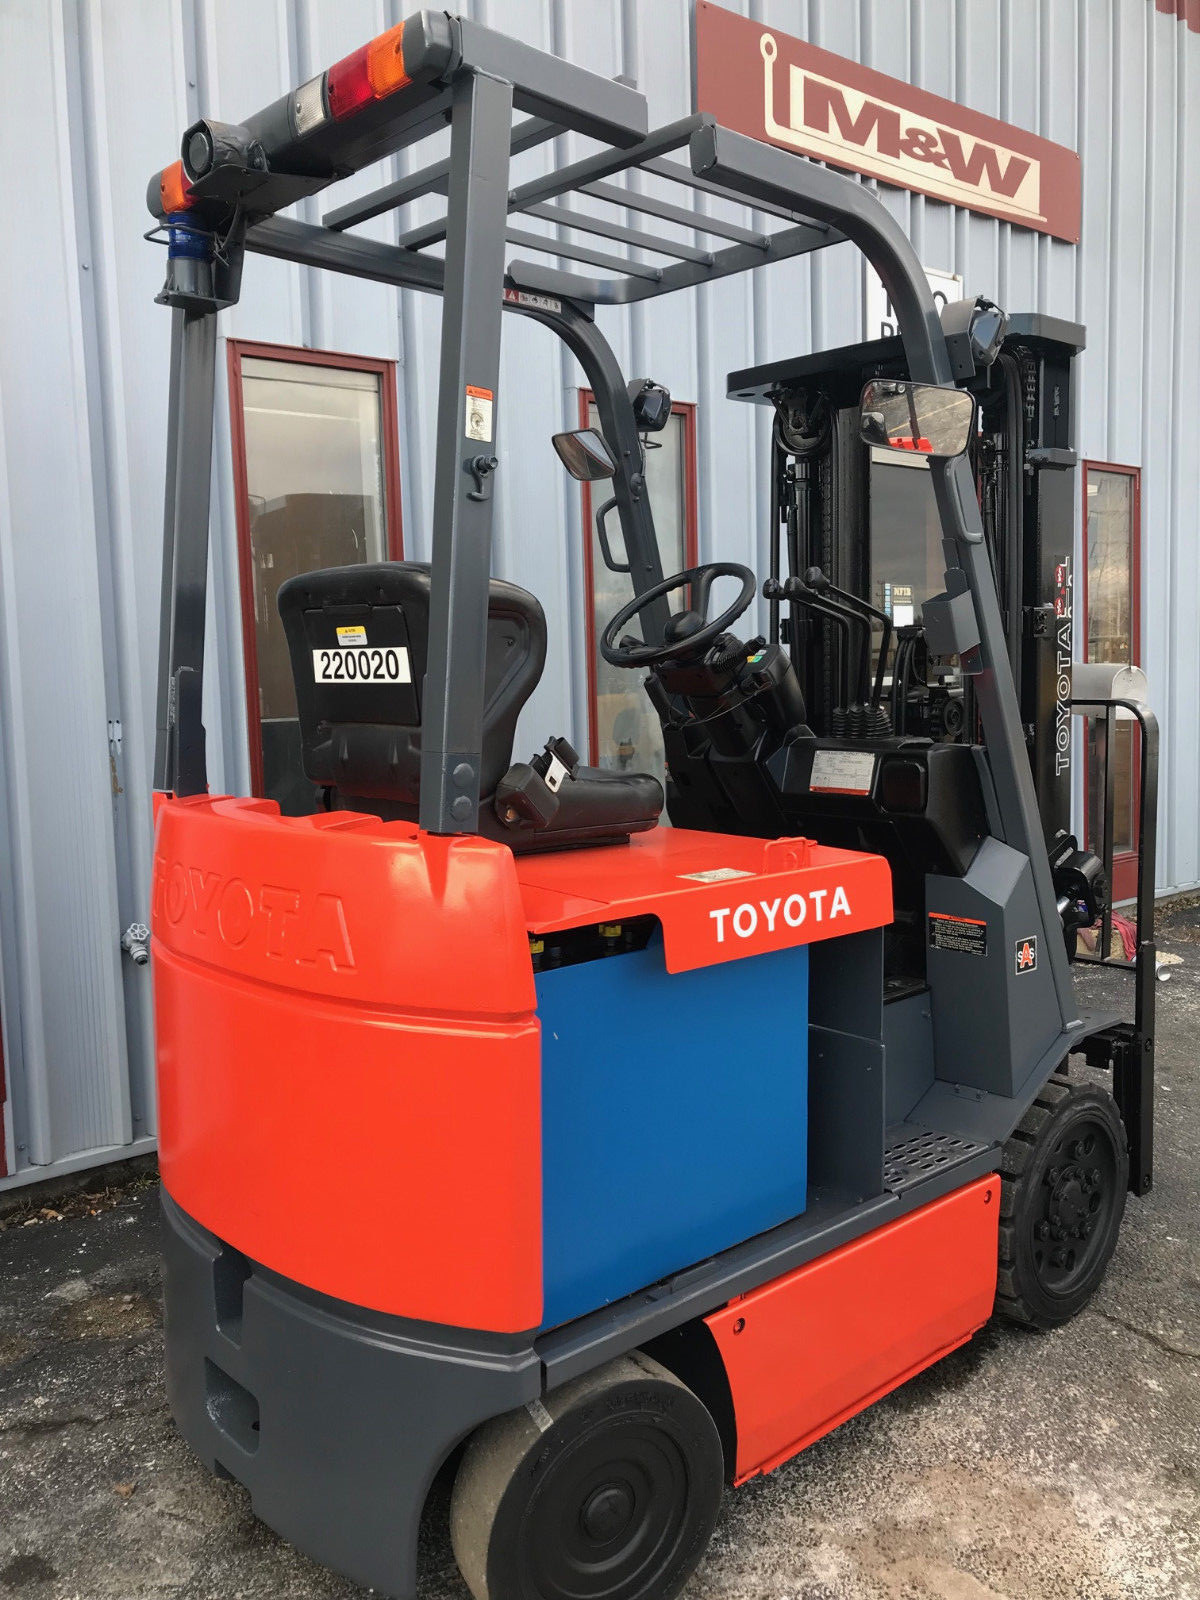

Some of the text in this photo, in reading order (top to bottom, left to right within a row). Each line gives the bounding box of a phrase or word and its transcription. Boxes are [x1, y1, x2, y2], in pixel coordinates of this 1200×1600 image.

[803, 75, 1031, 198] M&W
[320, 650, 399, 680] 220020
[1056, 623, 1071, 776] TOYOTA
[709, 886, 851, 943] TOYOTA
